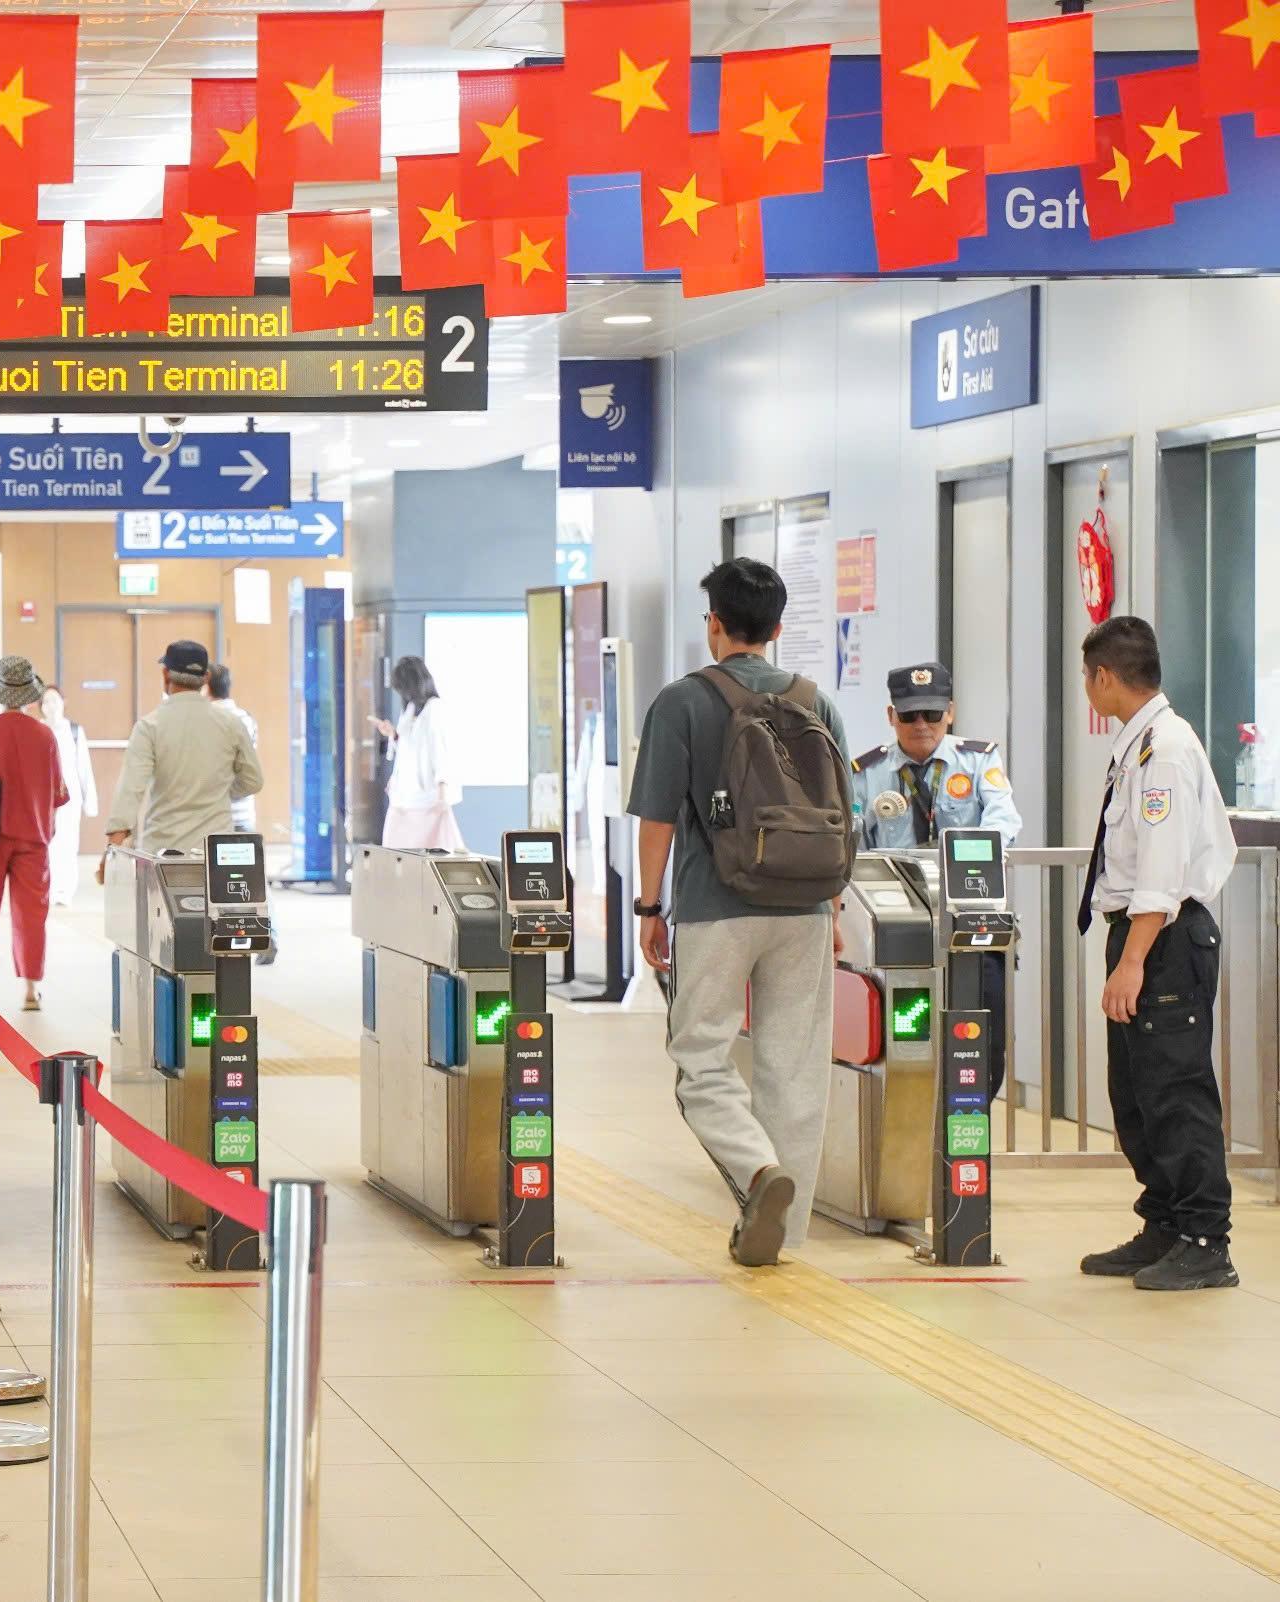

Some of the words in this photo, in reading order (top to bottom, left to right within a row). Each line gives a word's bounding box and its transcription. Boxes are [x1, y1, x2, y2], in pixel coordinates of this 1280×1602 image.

[1005, 187, 1090, 229] Gat
[148, 306, 288, 338] erminal
[336, 305, 425, 337] :16
[440, 315, 476, 373] 2
[52, 360, 128, 392] Tien
[138, 359, 287, 391] Terminal
[329, 359, 424, 391] 11:26
[8, 443, 64, 471] Suối
[71, 446, 124, 471] Tiên
[142, 452, 171, 496] 2
[2, 478, 40, 497] Tien
[44, 478, 123, 497] Terminal
[163, 511, 187, 550] 2
[220, 1132, 251, 1144] Zalo
[516, 1126, 547, 1138] Zalo
[952, 1125, 985, 1137] Zalo
[220, 1144, 247, 1158] pay
[515, 1138, 543, 1152] pay
[952, 1137, 980, 1150] pay
[521, 1184, 541, 1197] Pay
[959, 1182, 979, 1194] Pay
